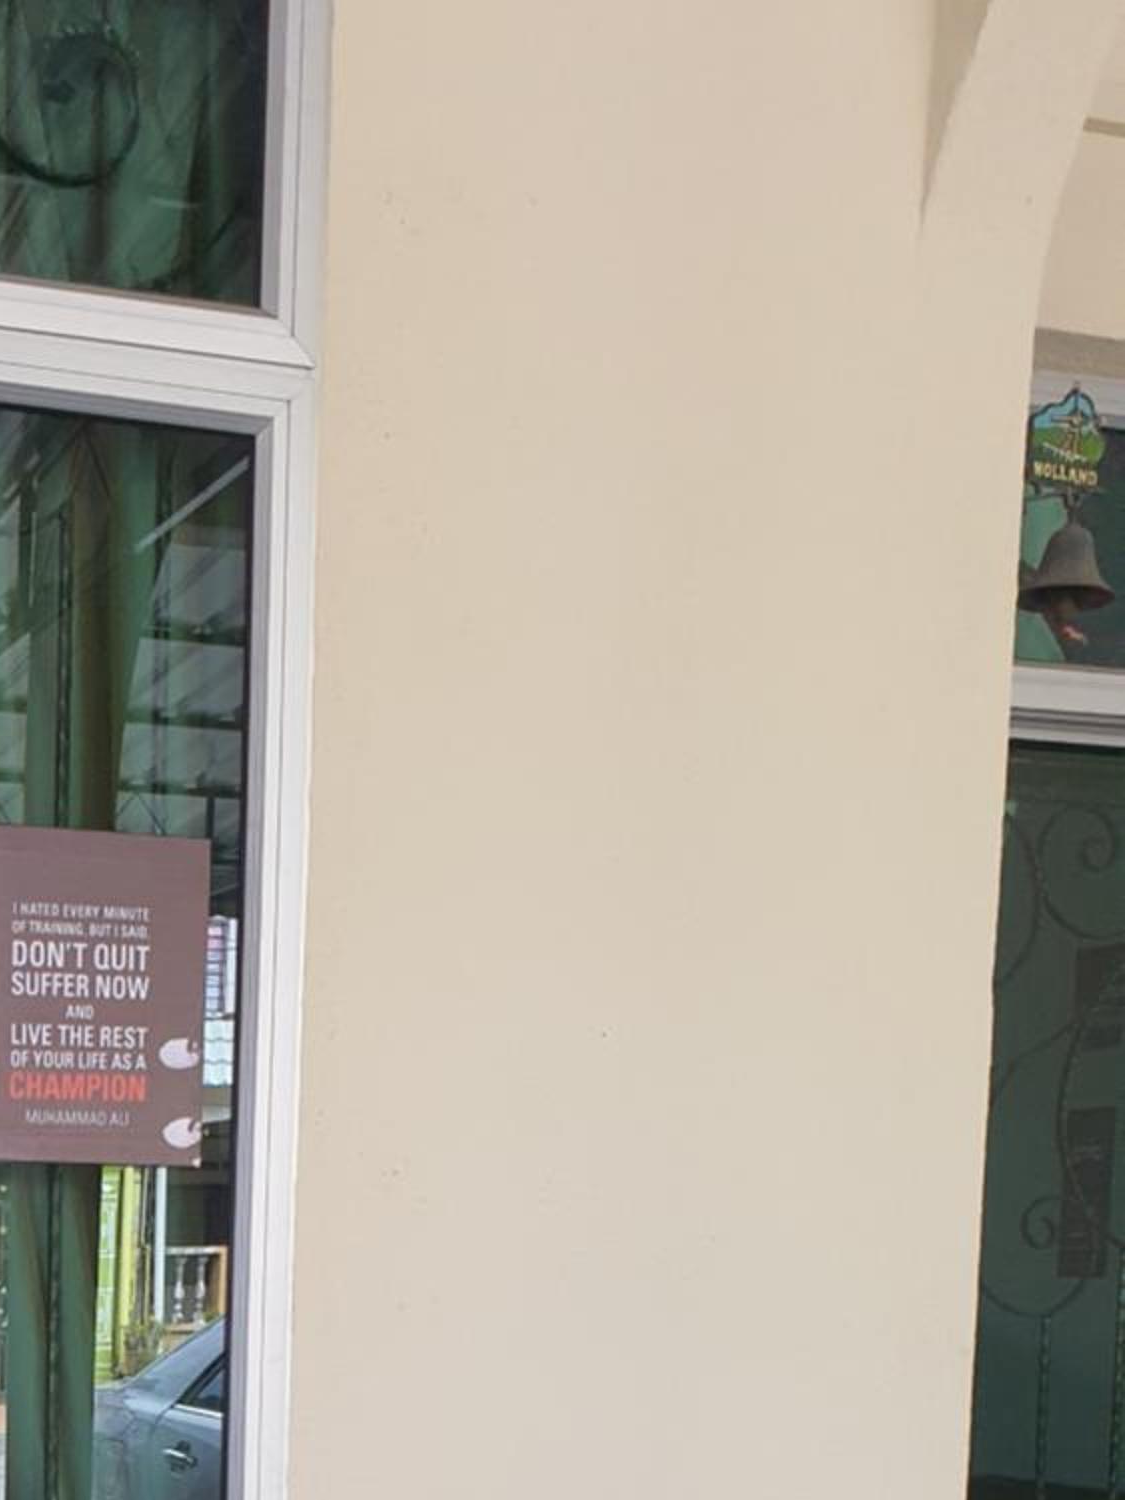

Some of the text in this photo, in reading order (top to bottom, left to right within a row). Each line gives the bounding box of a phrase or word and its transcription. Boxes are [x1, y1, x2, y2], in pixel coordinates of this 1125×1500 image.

[21, 902, 59, 917] HATED
[63, 904, 99, 918] EVERY
[104, 906, 150, 922] MINUTE
[11, 920, 26, 934] OF
[89, 922, 111, 938] BUT
[12, 940, 150, 972] DON'T QUIT
[11, 971, 150, 1000] SUFFER NOW
[65, 1004, 94, 1020] AND
[10, 1023, 148, 1049] LIVE THE REST
[10, 1051, 147, 1071] OF YOUR LIFE AS A
[9, 1071, 148, 1102] CHAMPION
[26, 1109, 130, 1127] MUHAMMAD ALI
